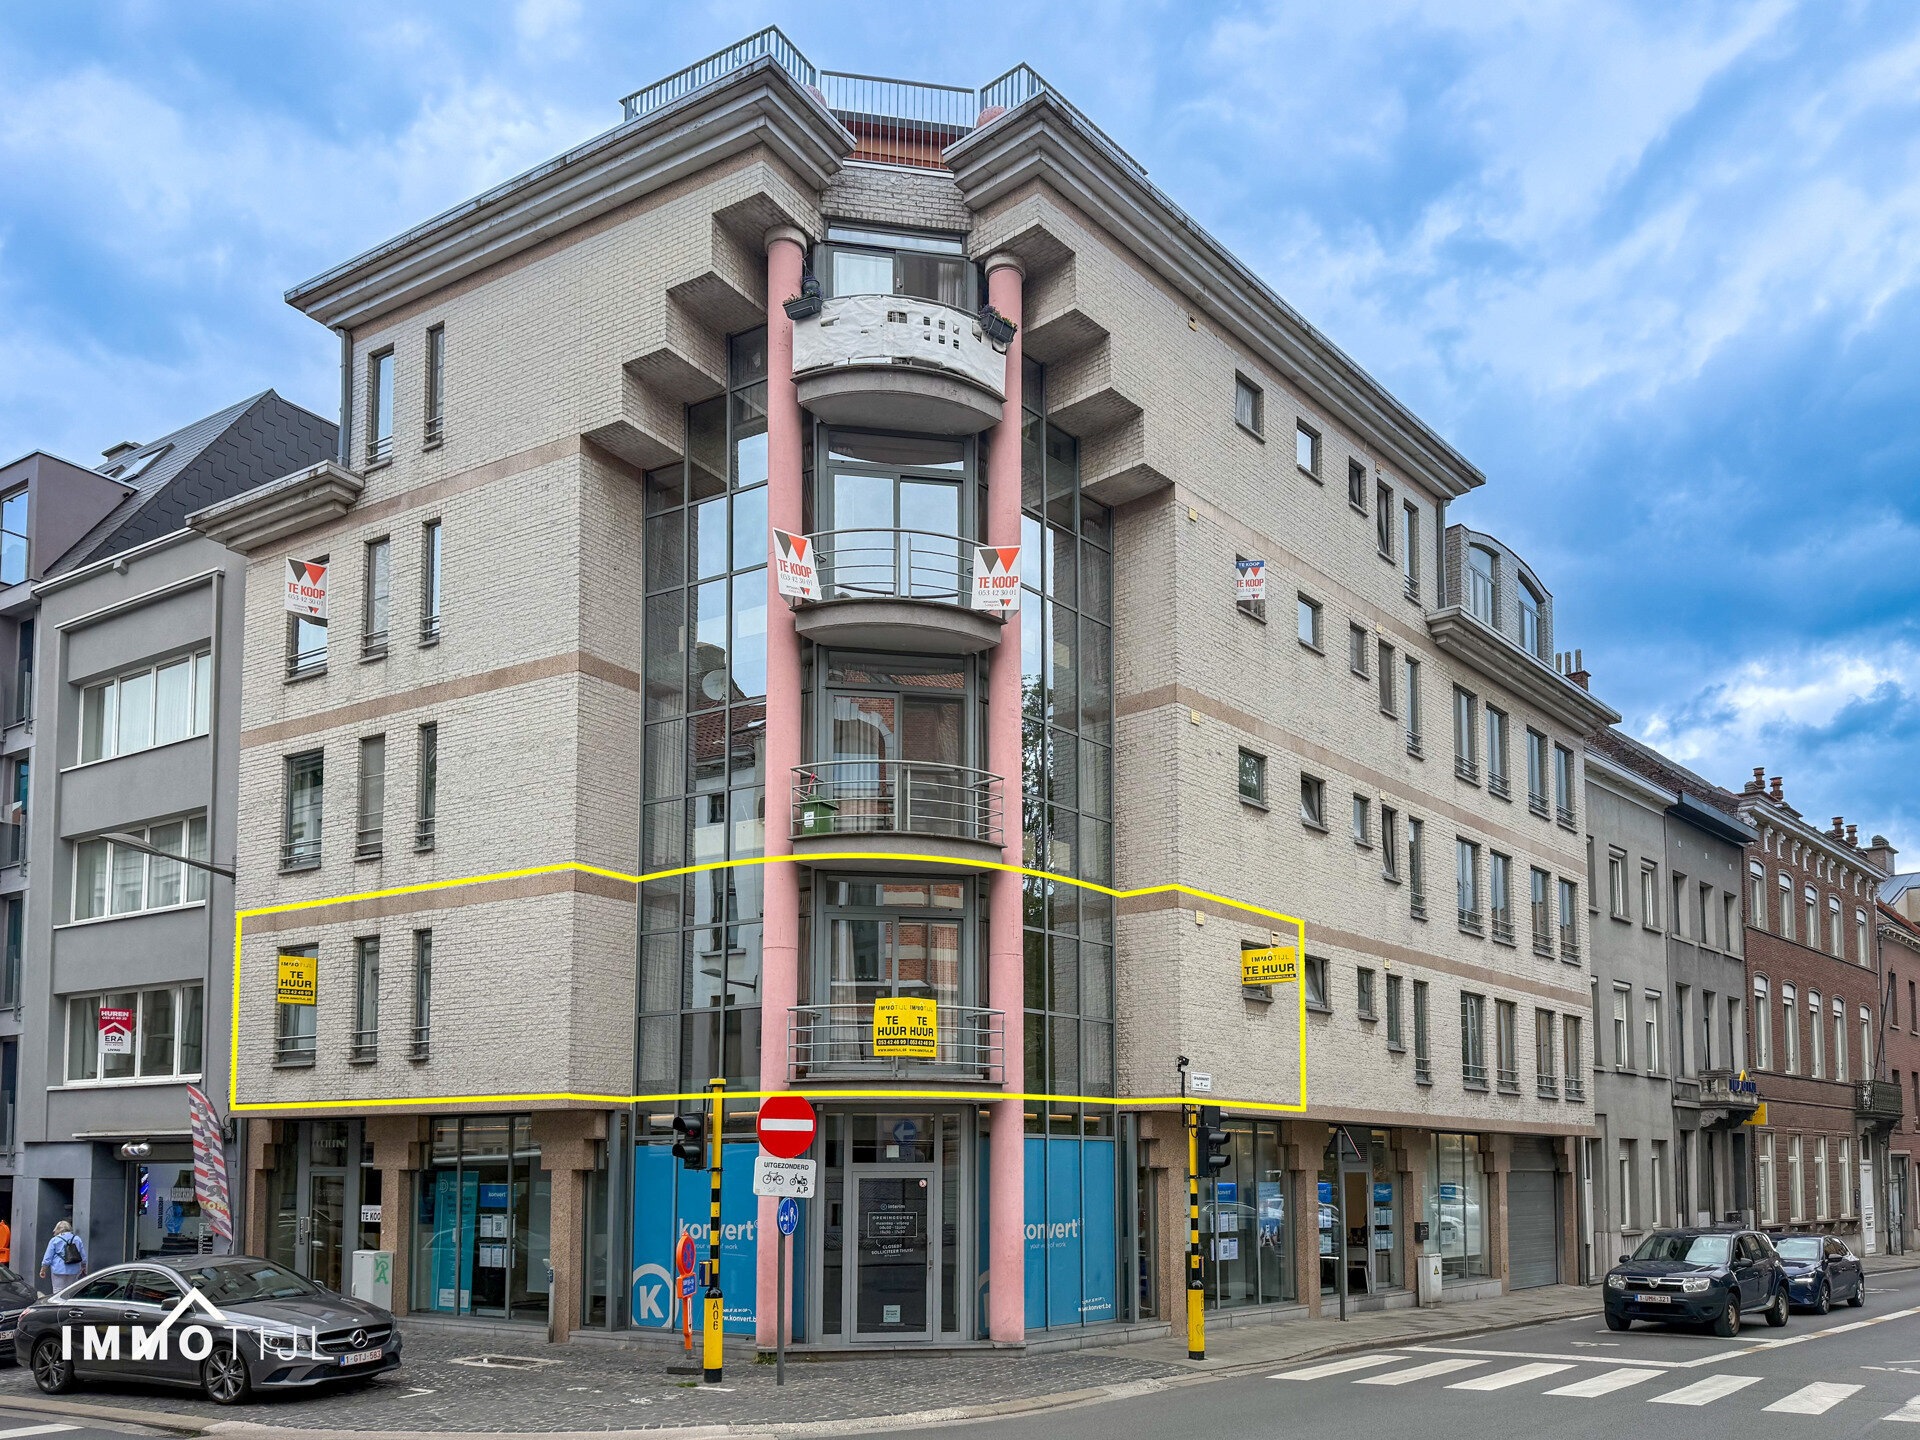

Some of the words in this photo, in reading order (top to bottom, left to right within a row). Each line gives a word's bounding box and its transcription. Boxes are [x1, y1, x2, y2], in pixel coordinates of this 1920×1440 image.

[778, 558, 788, 572] TE
[790, 562, 812, 578] KOOP
[978, 576, 990, 588] TE
[992, 576, 1018, 588] KOOP
[1246, 578, 1264, 587] KOOP
[288, 582, 298, 594] TE
[300, 585, 326, 600] KOOP
[1244, 966, 1258, 974] TE
[1262, 963, 1294, 974] HUUR
[290, 971, 304, 979] TE
[281, 979, 312, 988] HUUR
[886, 1016, 898, 1024] TE
[917, 1016, 928, 1026] TE
[878, 1027, 906, 1036] HUUR
[910, 1027, 934, 1036] HUUR
[764, 1162, 810, 1170] UITGEZONDERD
[362, 1212, 369, 1220] TE
[370, 1212, 381, 1220] KOO
[346, 1351, 380, 1363] 1-GTJ-583
